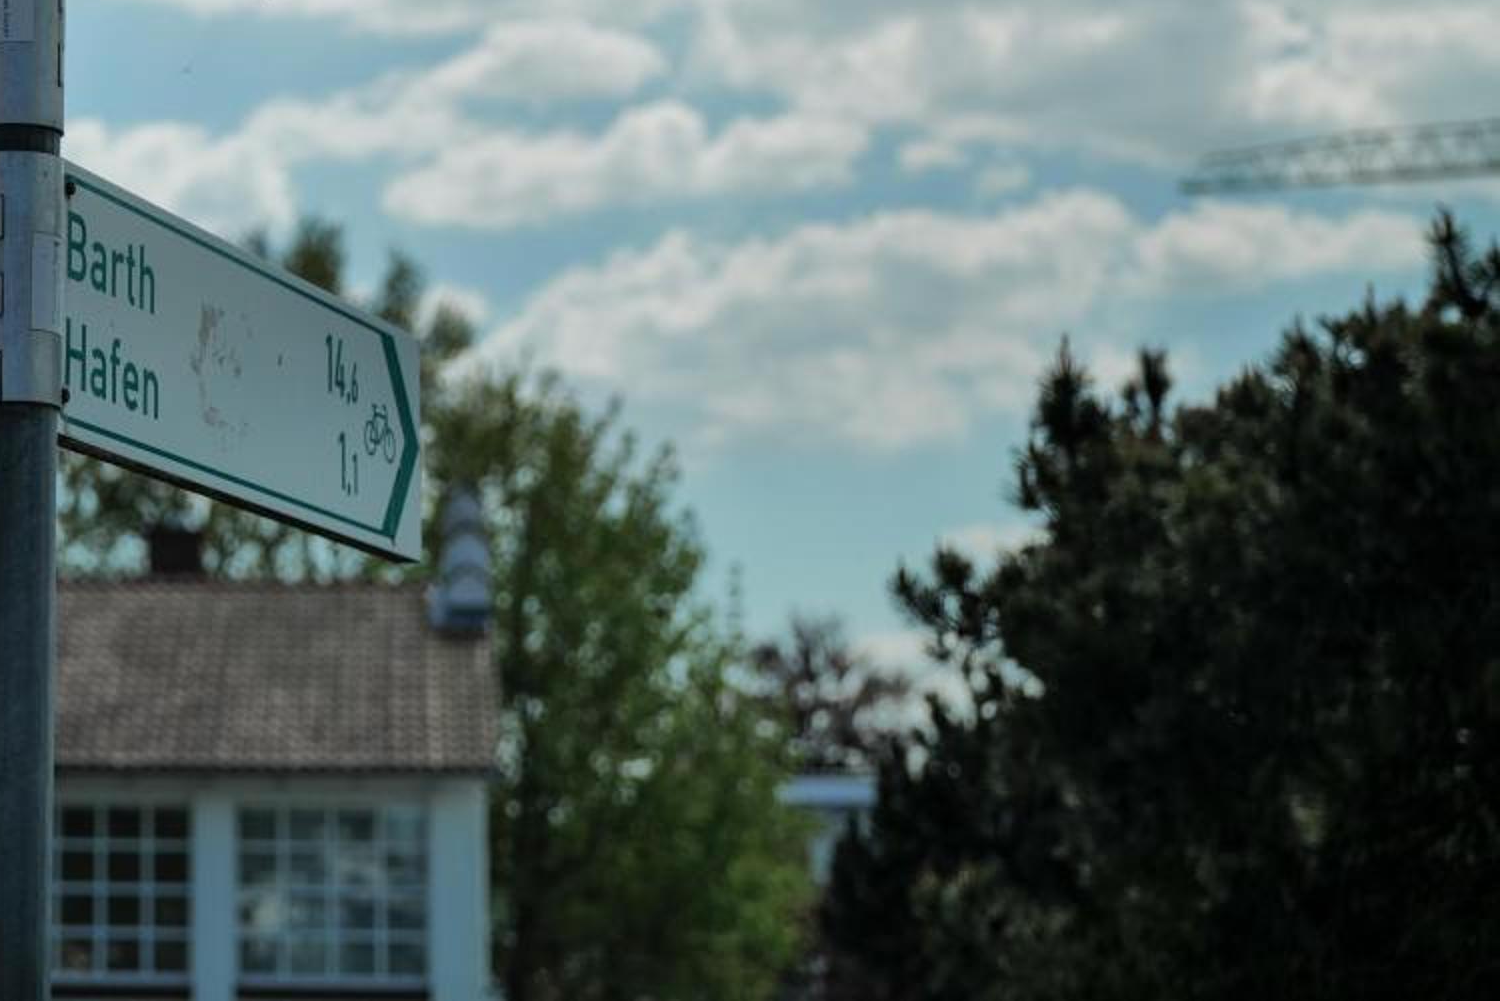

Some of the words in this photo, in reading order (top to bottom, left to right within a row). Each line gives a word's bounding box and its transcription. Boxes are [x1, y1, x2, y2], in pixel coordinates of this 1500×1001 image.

[67, 210, 156, 315] Barth
[325, 333, 359, 403] 14,6
[65, 318, 160, 420] Hafen
[338, 431, 359, 496] 1,1
